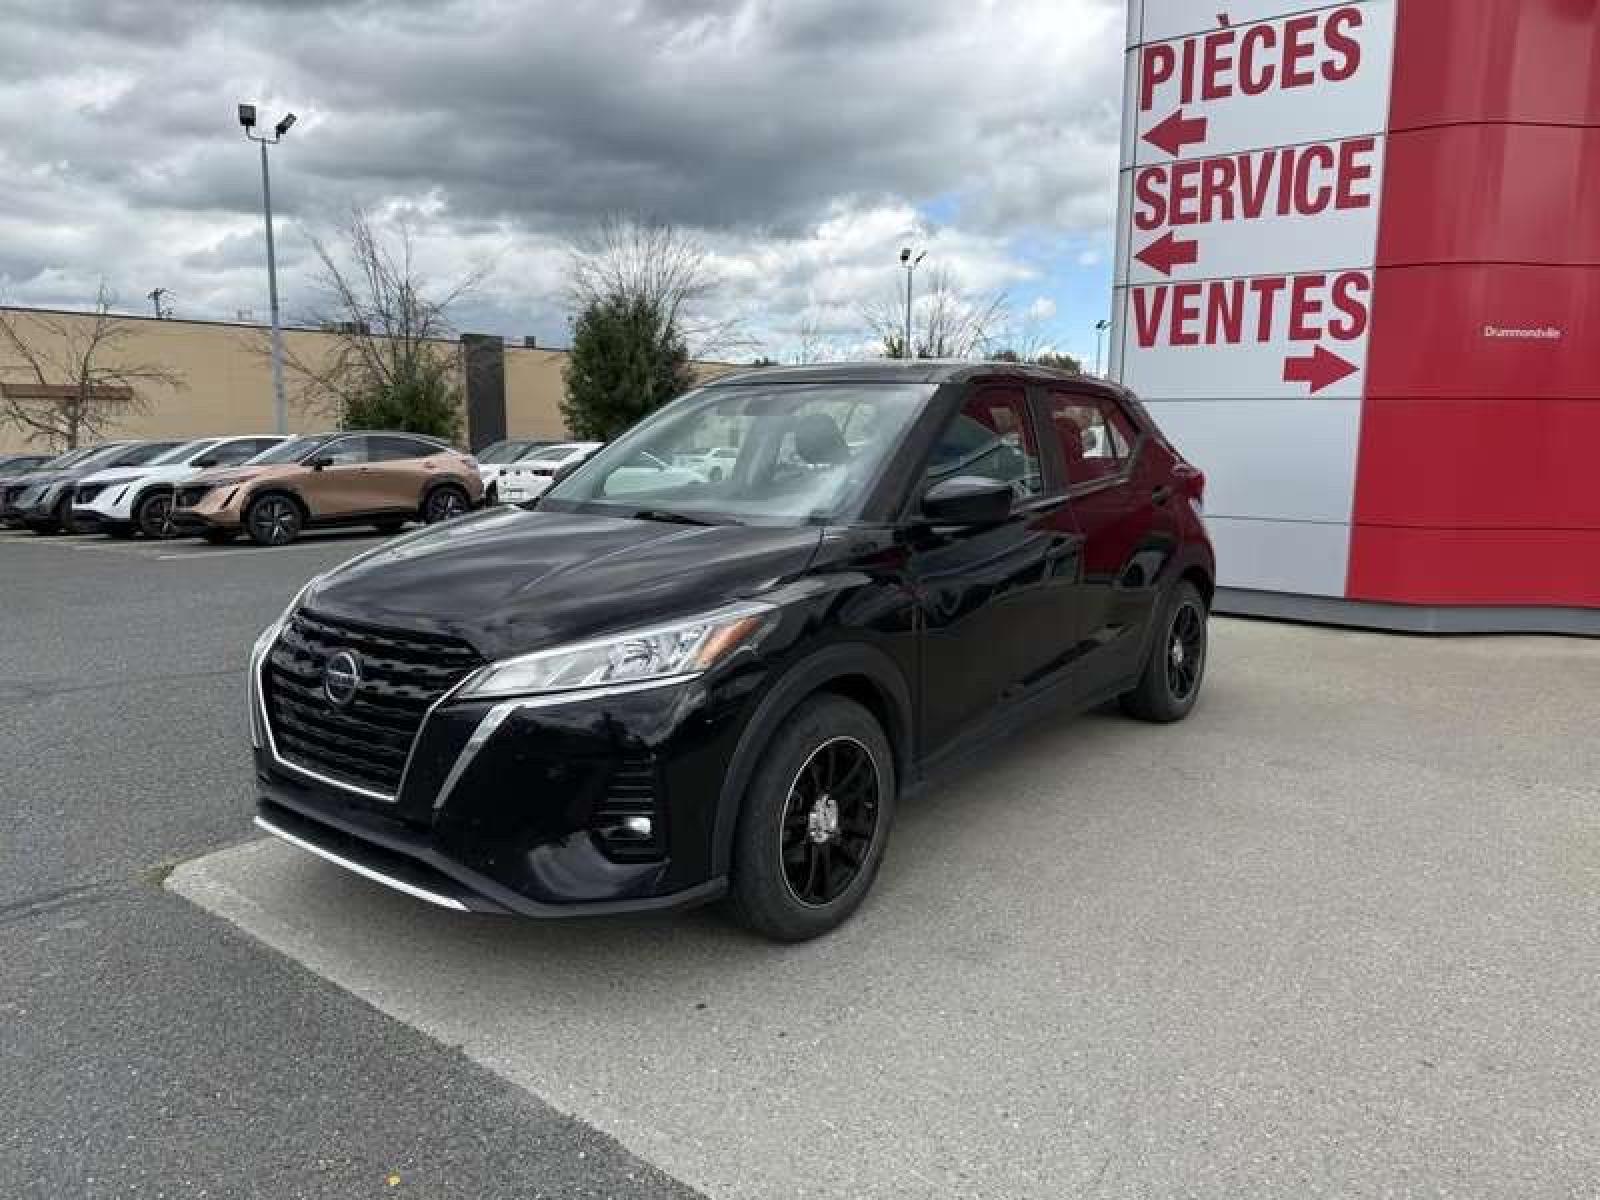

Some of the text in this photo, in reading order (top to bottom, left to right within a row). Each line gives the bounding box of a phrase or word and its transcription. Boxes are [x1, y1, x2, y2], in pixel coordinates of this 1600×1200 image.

[1141, 8, 1363, 110] PIÈCES
[1135, 138, 1375, 230] SERVICE
[1133, 272, 1370, 348] VENTES
